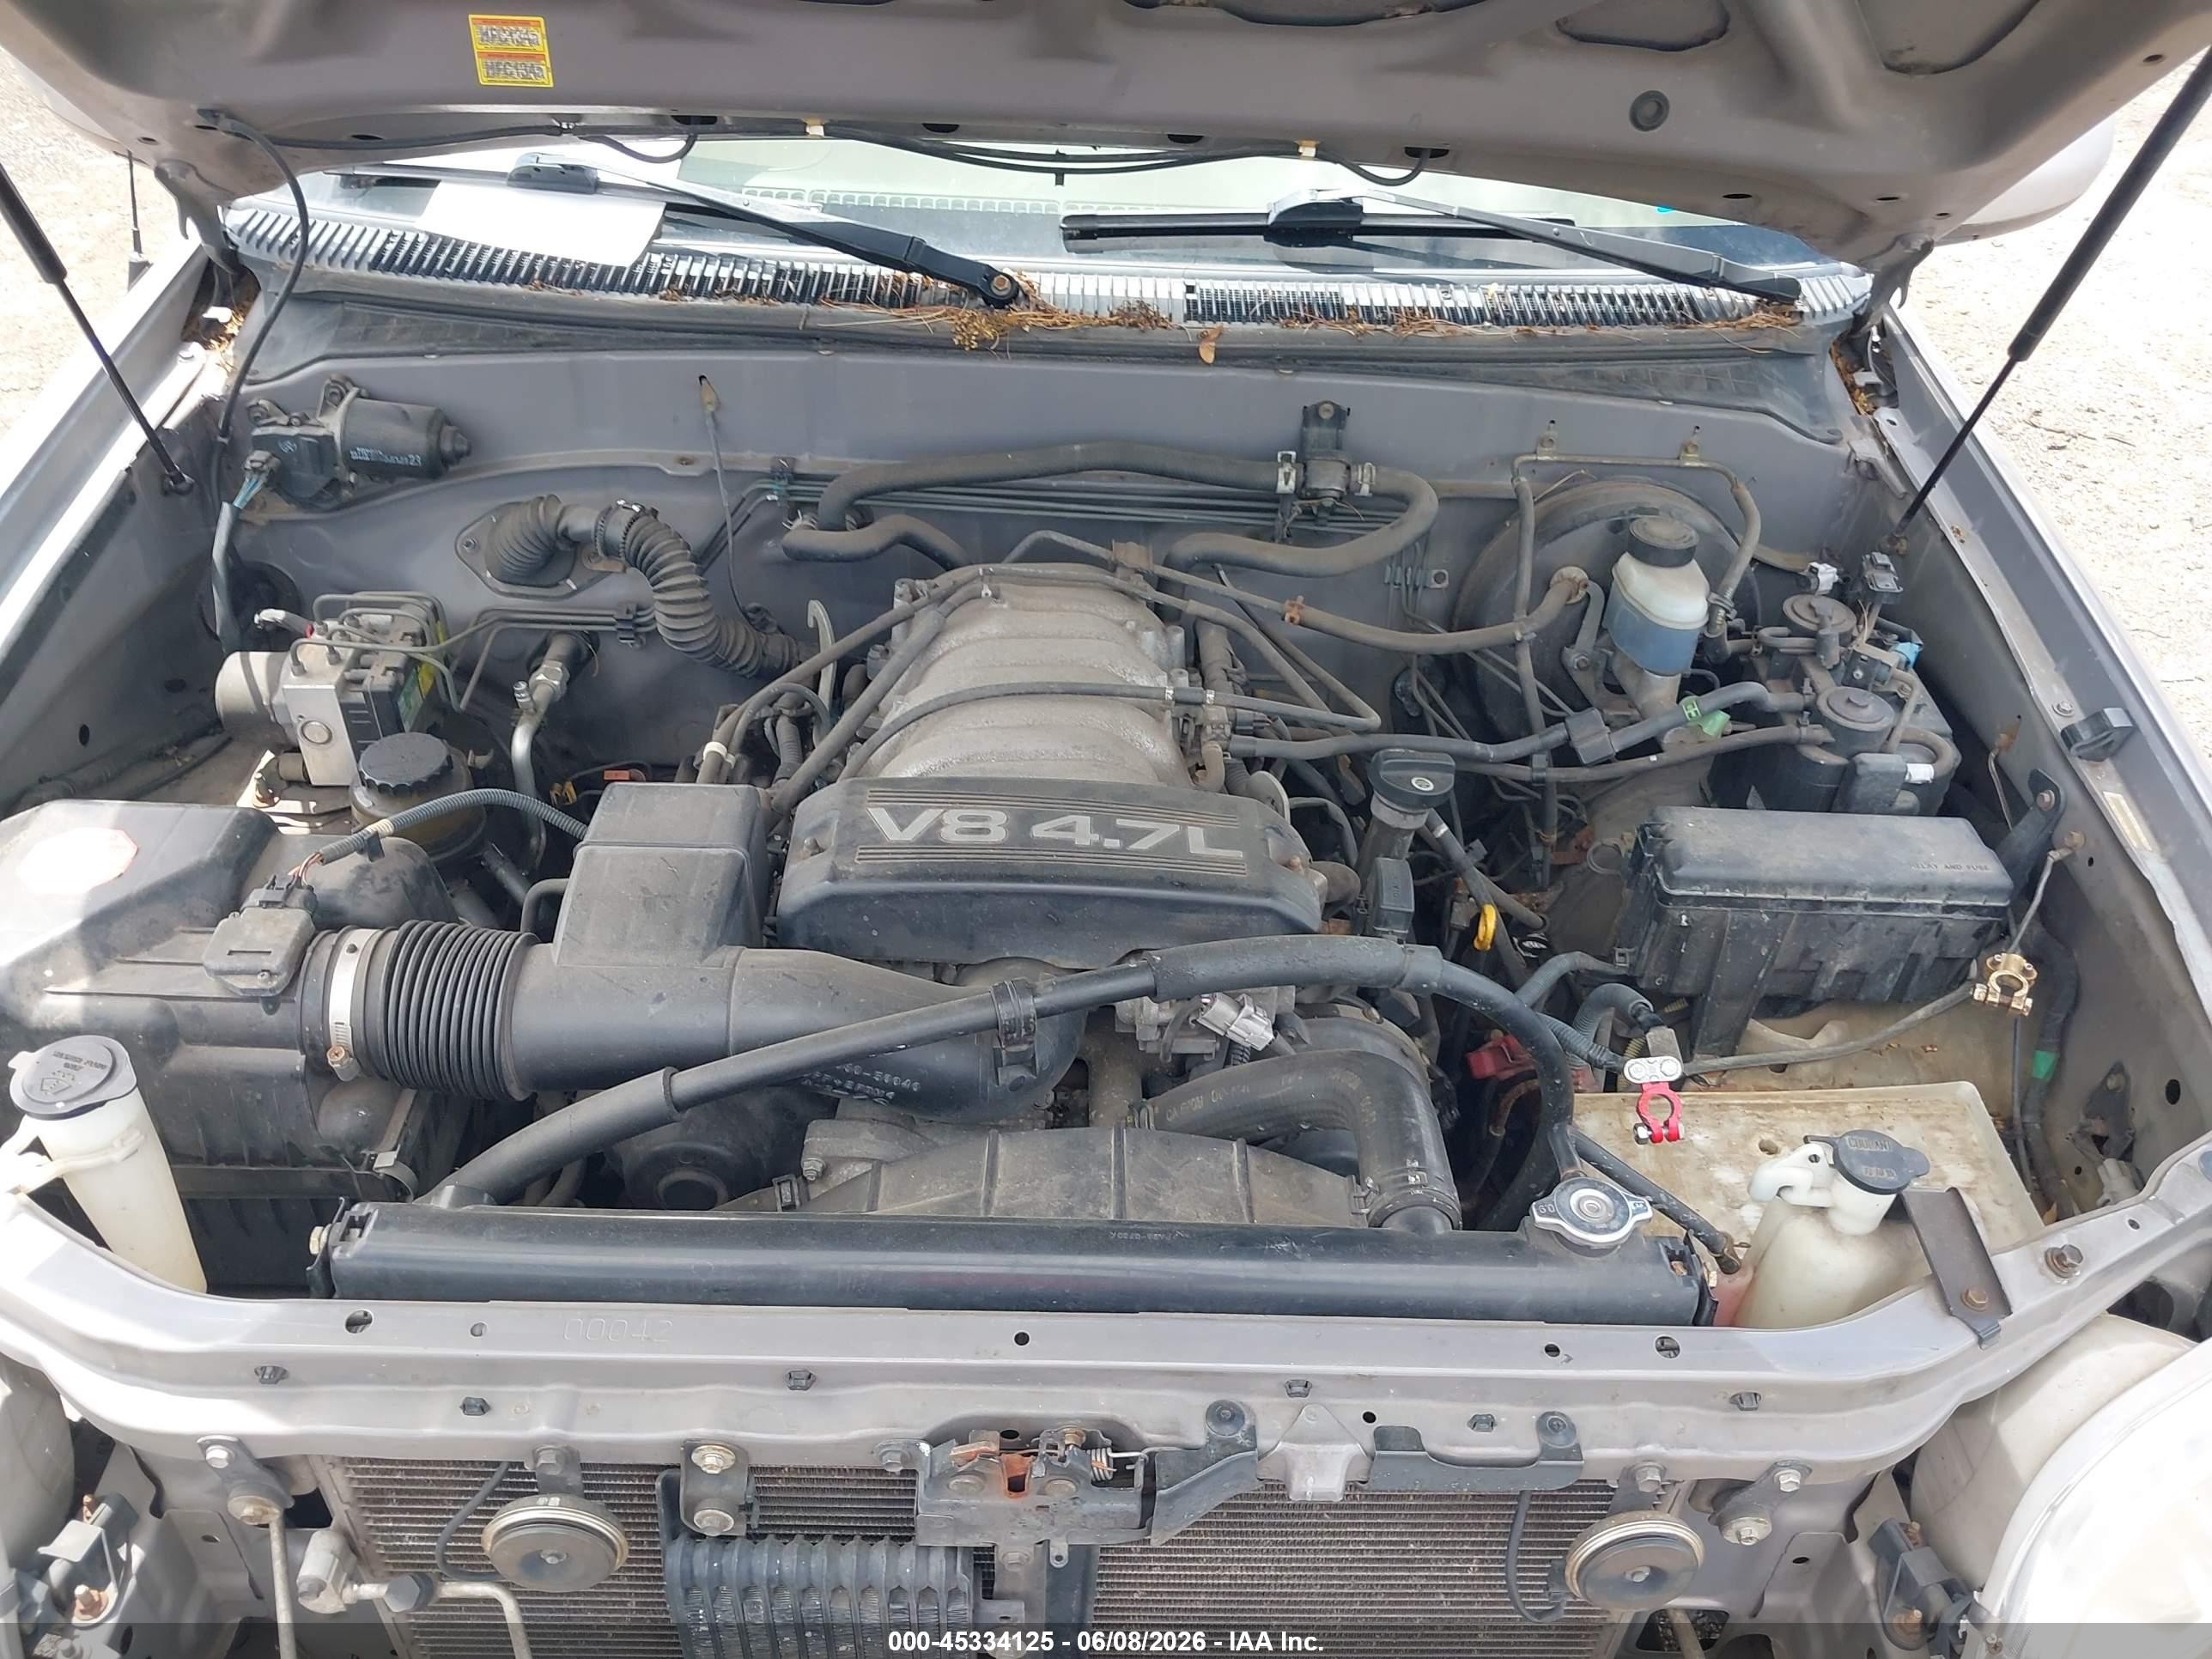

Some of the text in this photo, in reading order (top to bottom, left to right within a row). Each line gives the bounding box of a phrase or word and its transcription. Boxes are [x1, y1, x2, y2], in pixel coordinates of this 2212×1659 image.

[866, 806, 1243, 858] V8 4.7L
[563, 1317, 673, 1342] 00042
